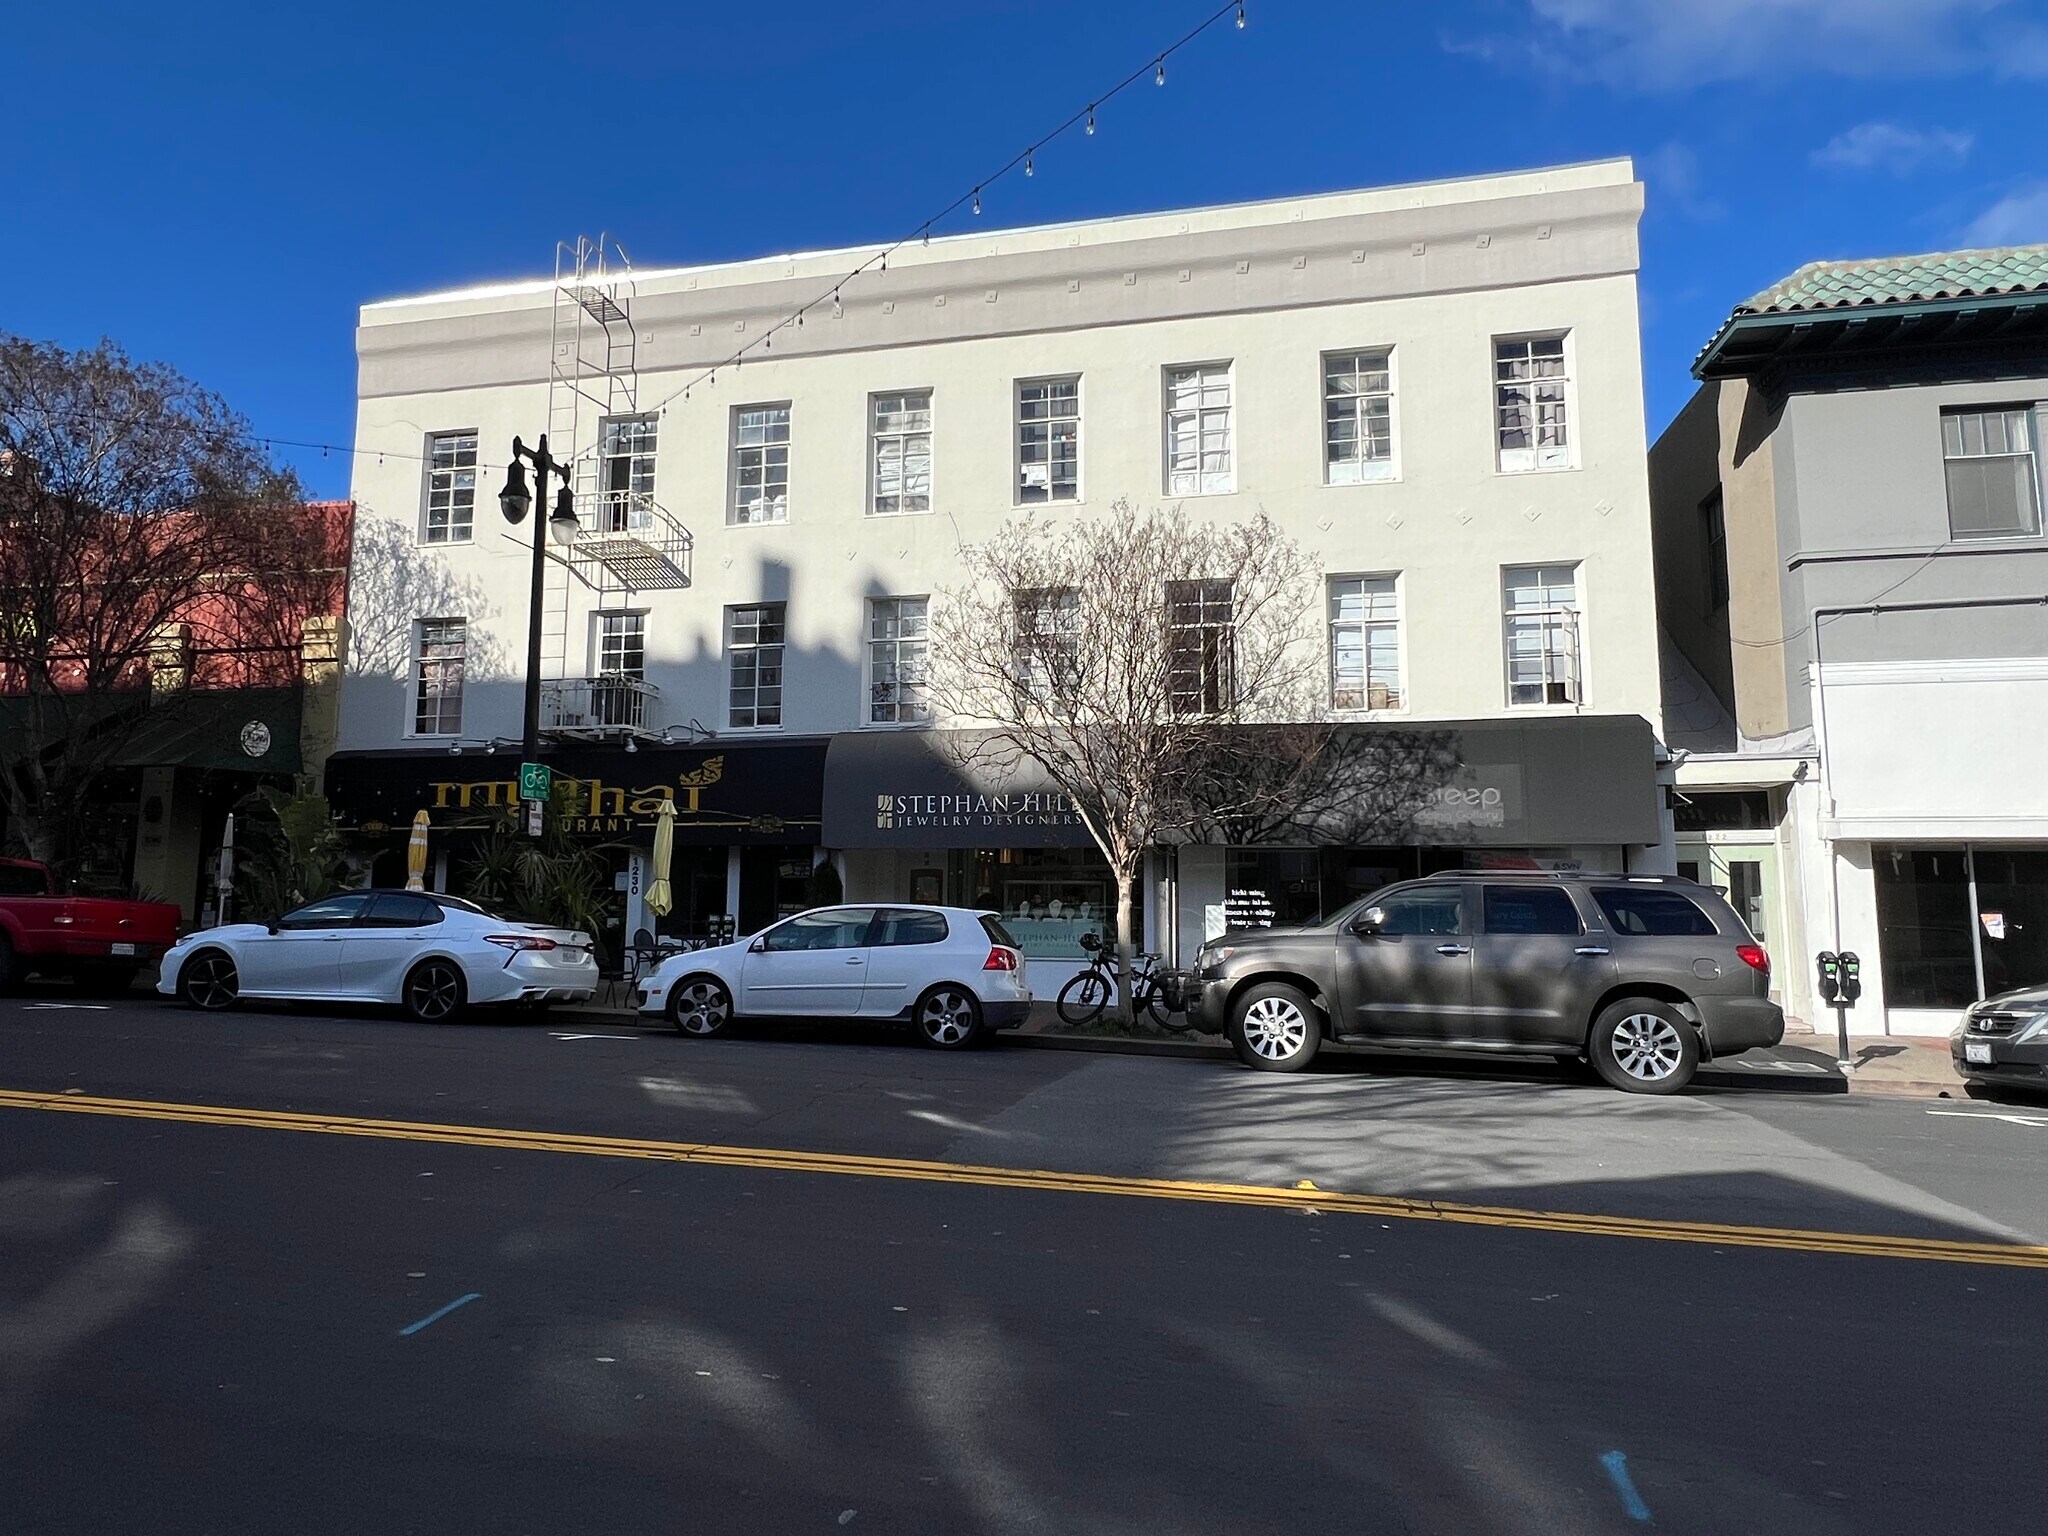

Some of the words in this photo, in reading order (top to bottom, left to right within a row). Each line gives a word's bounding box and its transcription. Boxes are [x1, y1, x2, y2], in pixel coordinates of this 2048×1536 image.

[496, 818, 634, 834] RURANT
[897, 815, 972, 828] JEWELRY
[983, 814, 1082, 826] DESIGNERS
[631, 856, 639, 895] 1230
